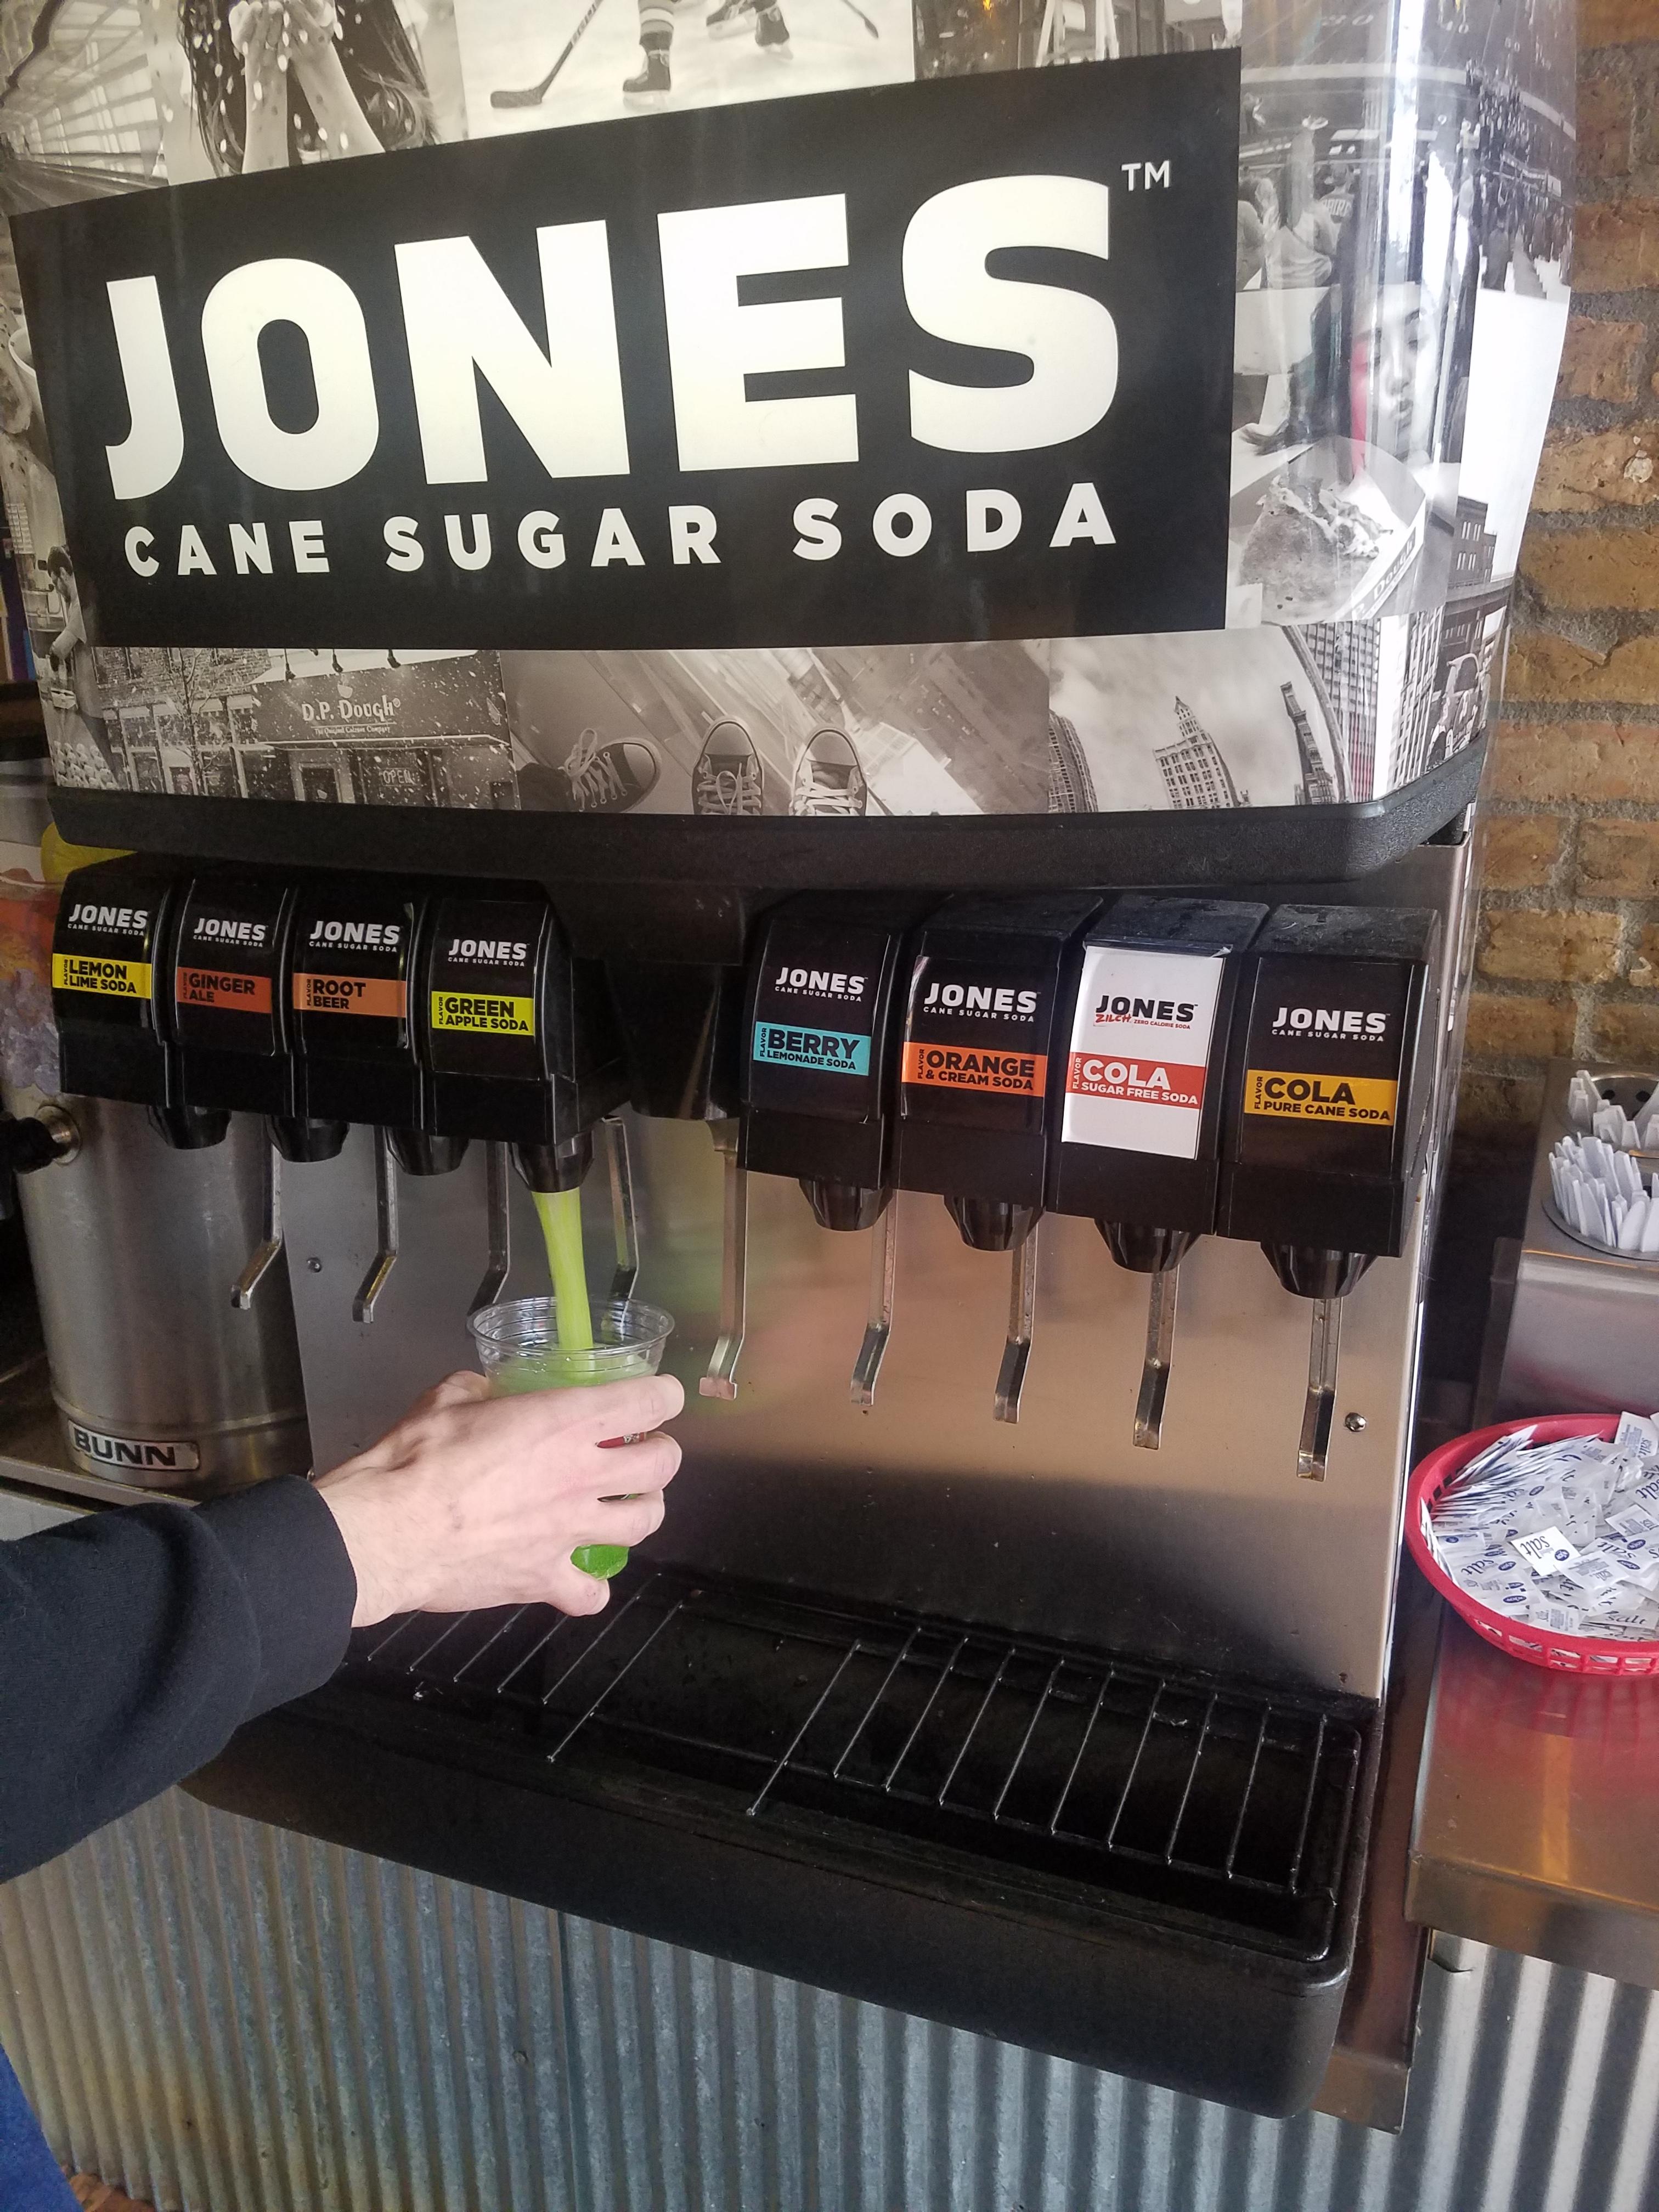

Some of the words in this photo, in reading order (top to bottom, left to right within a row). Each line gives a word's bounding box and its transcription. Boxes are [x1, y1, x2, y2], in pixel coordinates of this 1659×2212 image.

[105, 174, 1119, 500] JONES
[1121, 160, 1171, 191] TM
[124, 520, 330, 577] CANE
[382, 505, 721, 572] SUGAR
[792, 482, 1116, 561] SODA
[302, 701, 334, 723] D.P.
[68, 904, 149, 929] JONES
[92, 924, 119, 934] SUGAR
[194, 917, 266, 941] JONES
[310, 921, 400, 945] JONES
[215, 937, 240, 945] SUGAR
[337, 942, 368, 951] SUGAR
[449, 939, 527, 960] JONES
[69, 959, 127, 980] LEMON
[69, 975, 98, 990] LIME
[100, 978, 137, 994] SODA
[189, 973, 256, 995] GINGER
[313, 979, 366, 997] ROOT
[775, 967, 865, 995] JONES
[189, 989, 215, 1003] ALE
[313, 995, 349, 1010] BEER
[775, 986, 798, 995] CANE
[802, 990, 833, 999] SUGAR
[837, 994, 862, 1002] SODA
[924, 983, 1037, 1014] JONES
[445, 997, 515, 1018] GREEN
[923, 1006, 952, 1015] CANE
[959, 1009, 997, 1019] SUGAR
[1003, 1013, 1035, 1023] SODA
[1095, 995, 1194, 1023] JONES
[445, 1014, 488, 1029] APPLE
[490, 1018, 529, 1032] SODA
[1095, 1013, 1131, 1024] ZILCH
[1150, 1020, 1173, 1028] CALORIE
[1272, 1007, 1386, 1034] JONES
[768, 1029, 860, 1059] BERRY
[1271, 1028, 1301, 1037] CANE
[1307, 1031, 1347, 1040] SUGAR
[1352, 1034, 1384, 1042] SODA
[767, 1050, 825, 1065] LEMONADE
[826, 1057, 856, 1070] SODA
[926, 1050, 1035, 1078] ORANGE
[926, 1069, 935, 1080] &
[938, 1071, 989, 1086] CREAM
[992, 1076, 1034, 1091] SODA
[1072, 1056, 1082, 1090] FLAVOR
[1082, 1059, 1171, 1091] COLA
[1081, 1082, 1124, 1096] SUGAR
[1126, 1086, 1159, 1100] FREE
[1161, 1090, 1198, 1105] SODA
[1254, 1076, 1263, 1109] FLAVOR
[1264, 1077, 1356, 1105] COLA
[1263, 1100, 1301, 1113] PURE
[1305, 1104, 1345, 1117] CANE
[1348, 1108, 1391, 1121] SODA
[74, 1427, 176, 1466] BUNN
[1520, 1536, 1550, 1559] salt
[1461, 1559, 1494, 1576] salt
